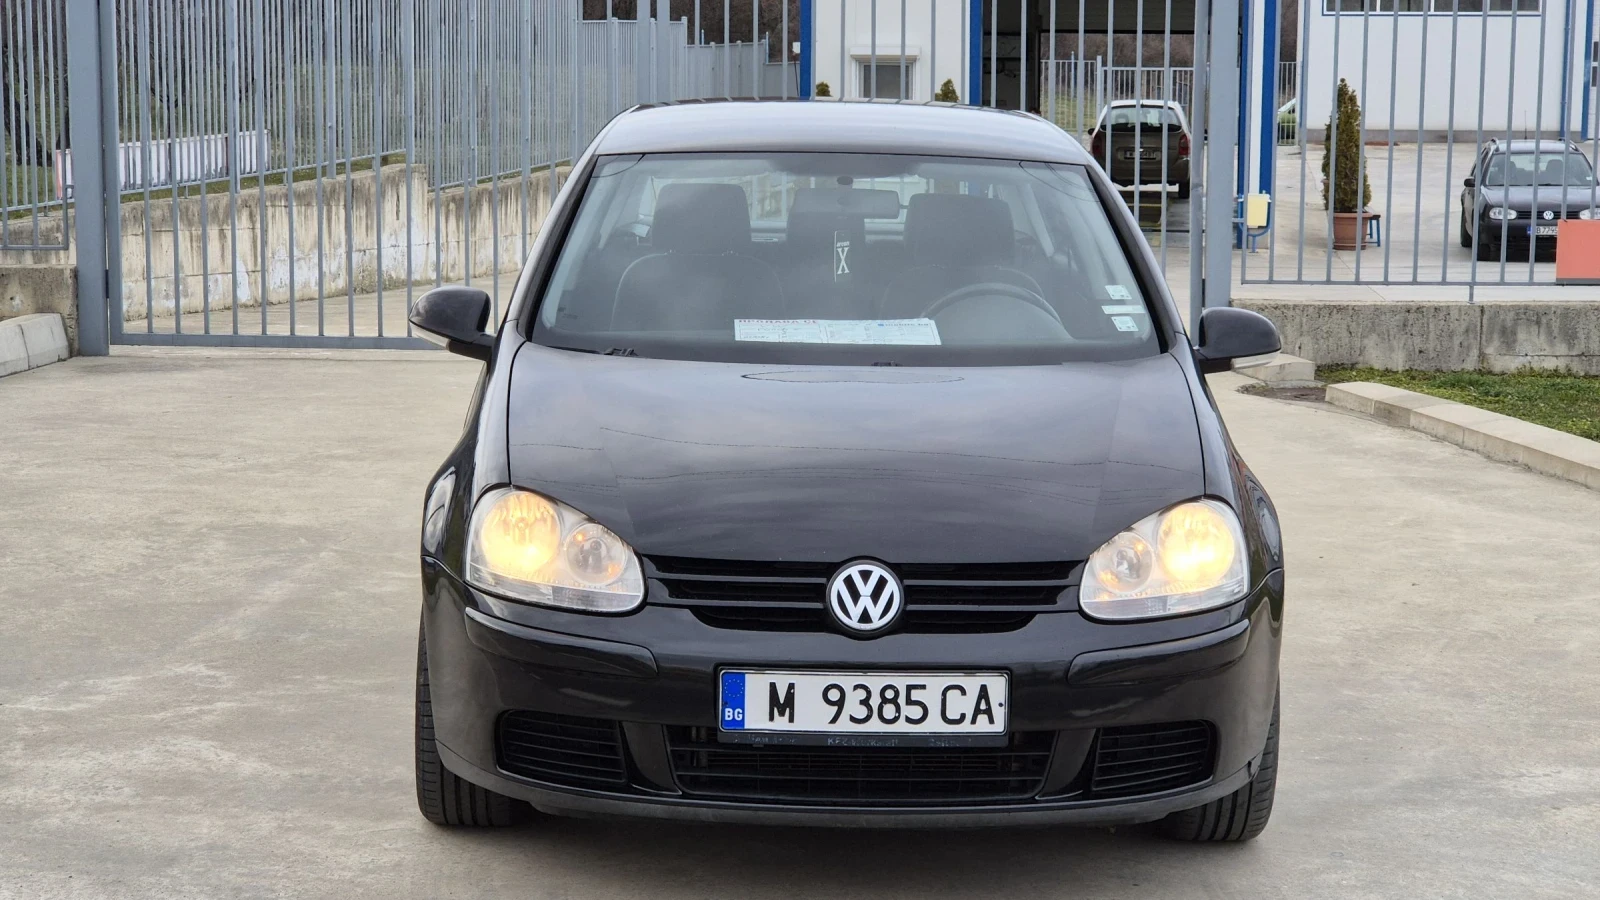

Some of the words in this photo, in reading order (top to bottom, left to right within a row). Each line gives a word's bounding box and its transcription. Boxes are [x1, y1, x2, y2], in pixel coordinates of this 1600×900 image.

[831, 565, 900, 630] VW
[724, 708, 743, 721] BG
[768, 682, 796, 724] M
[822, 683, 930, 725] 9385
[940, 684, 996, 725] CA
